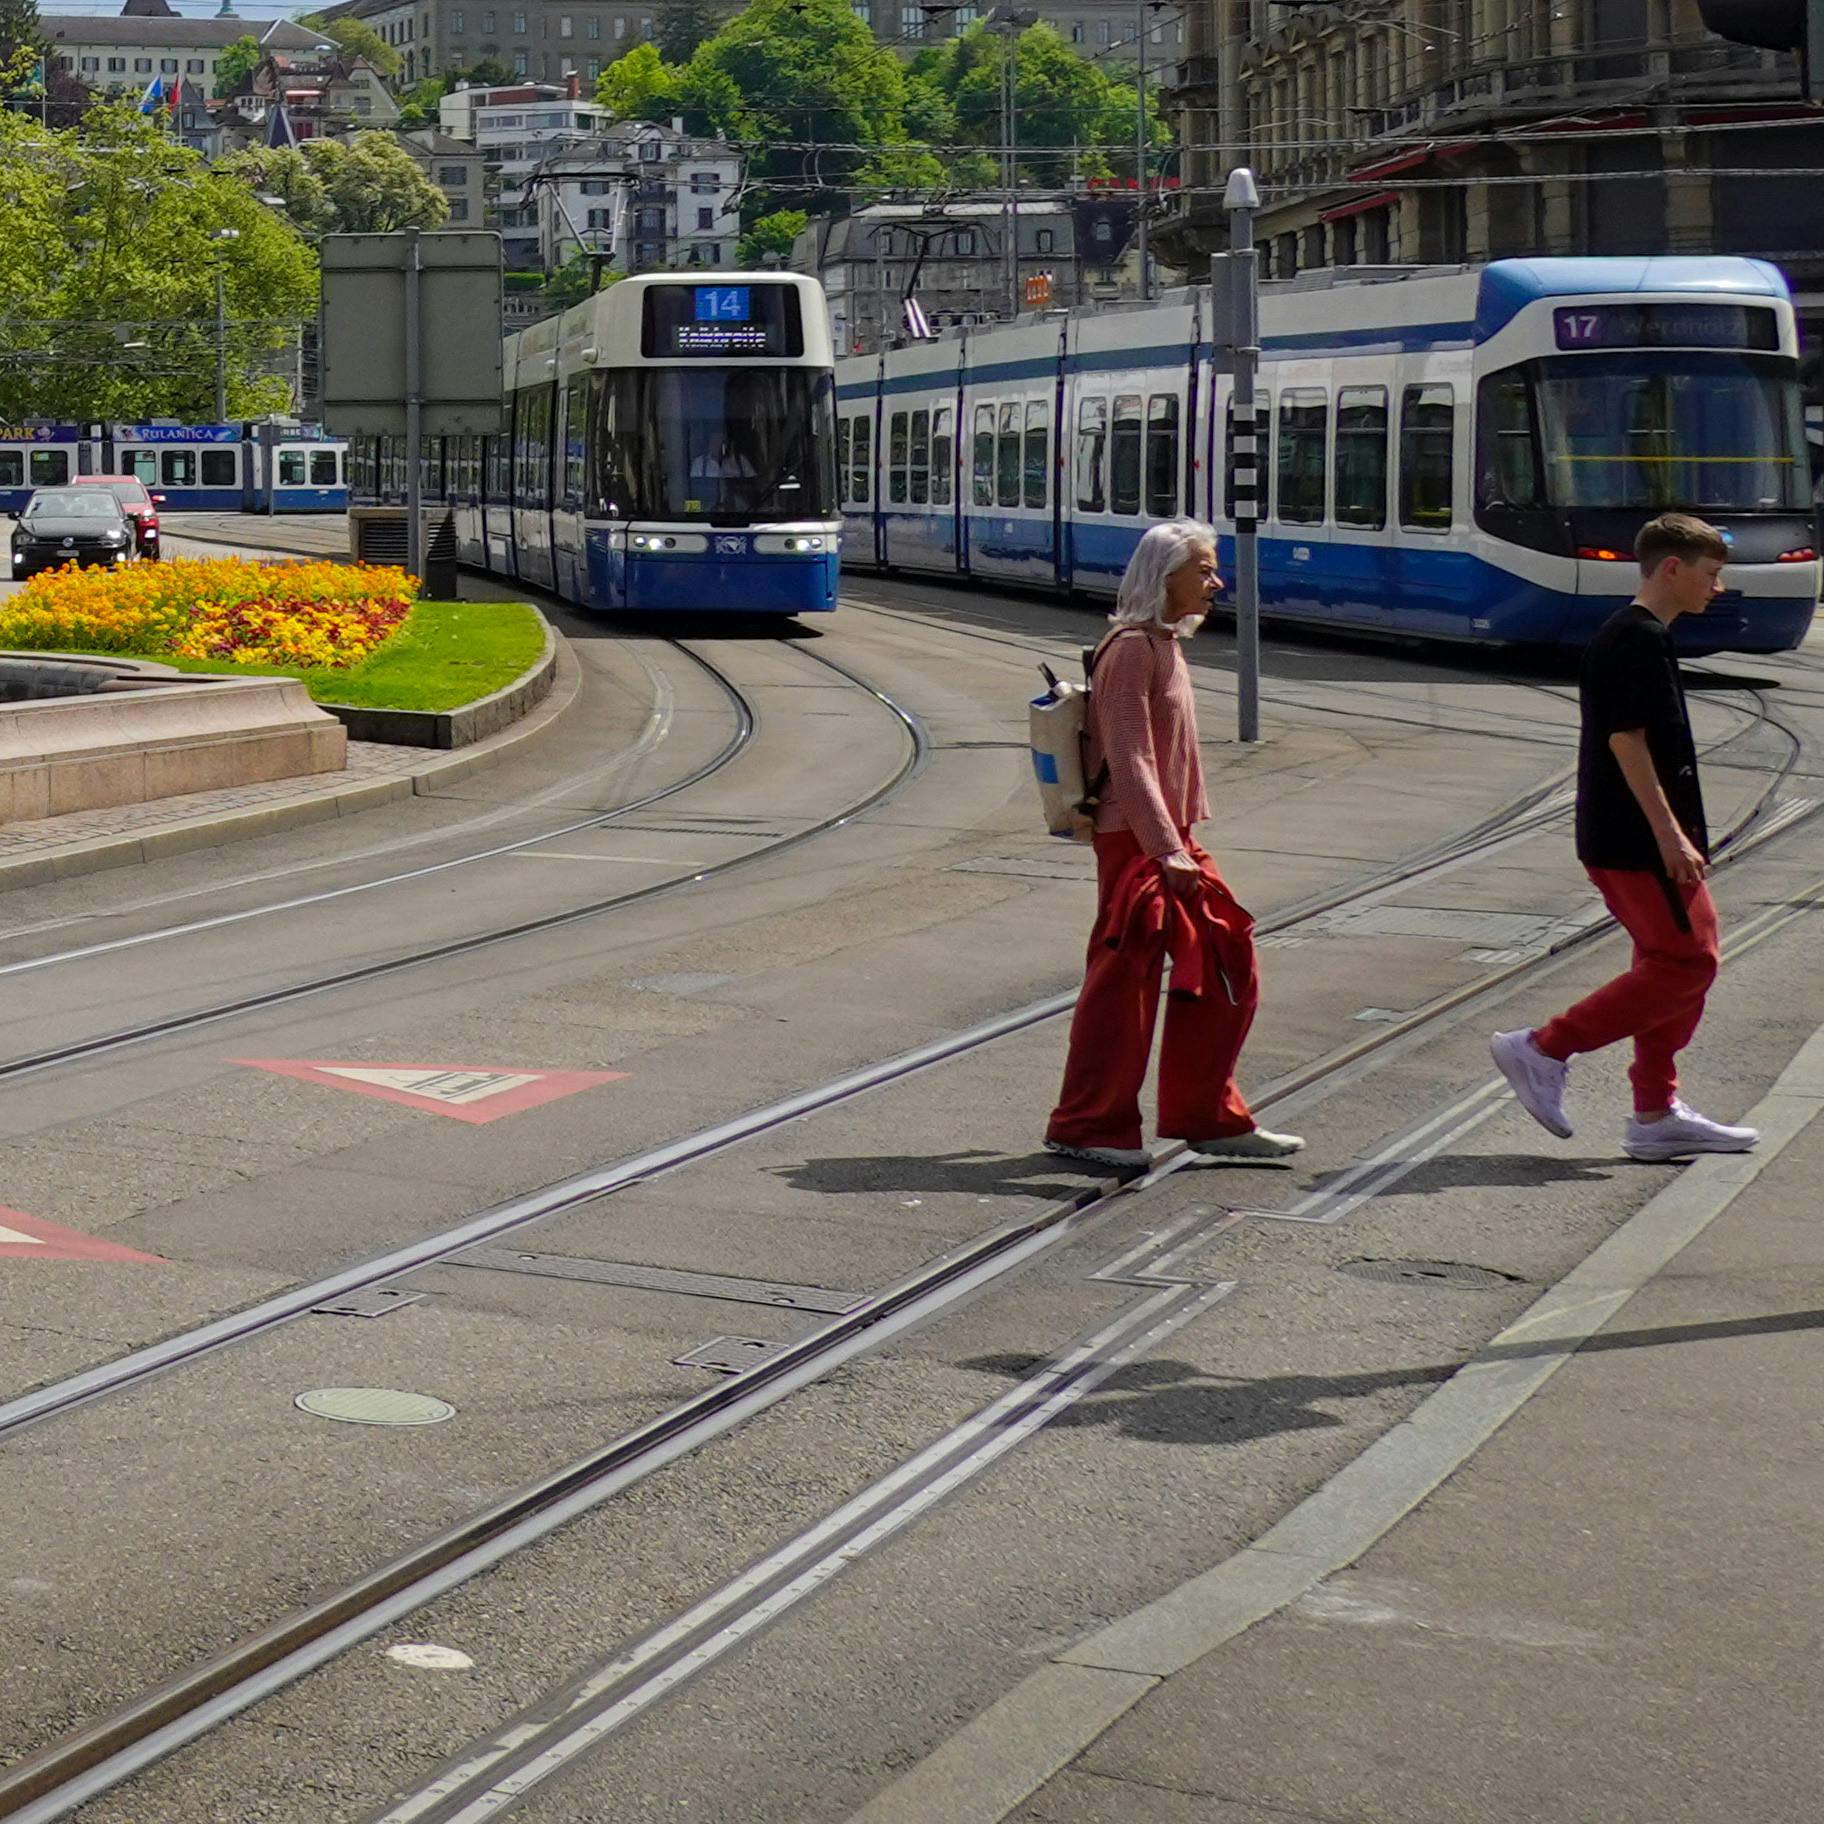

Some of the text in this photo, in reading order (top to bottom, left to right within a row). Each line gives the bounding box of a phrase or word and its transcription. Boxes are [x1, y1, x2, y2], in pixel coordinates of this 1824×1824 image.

[705, 290, 742, 317] 14
[1563, 315, 1599, 339] 17
[142, 426, 213, 440] RULANTICA
